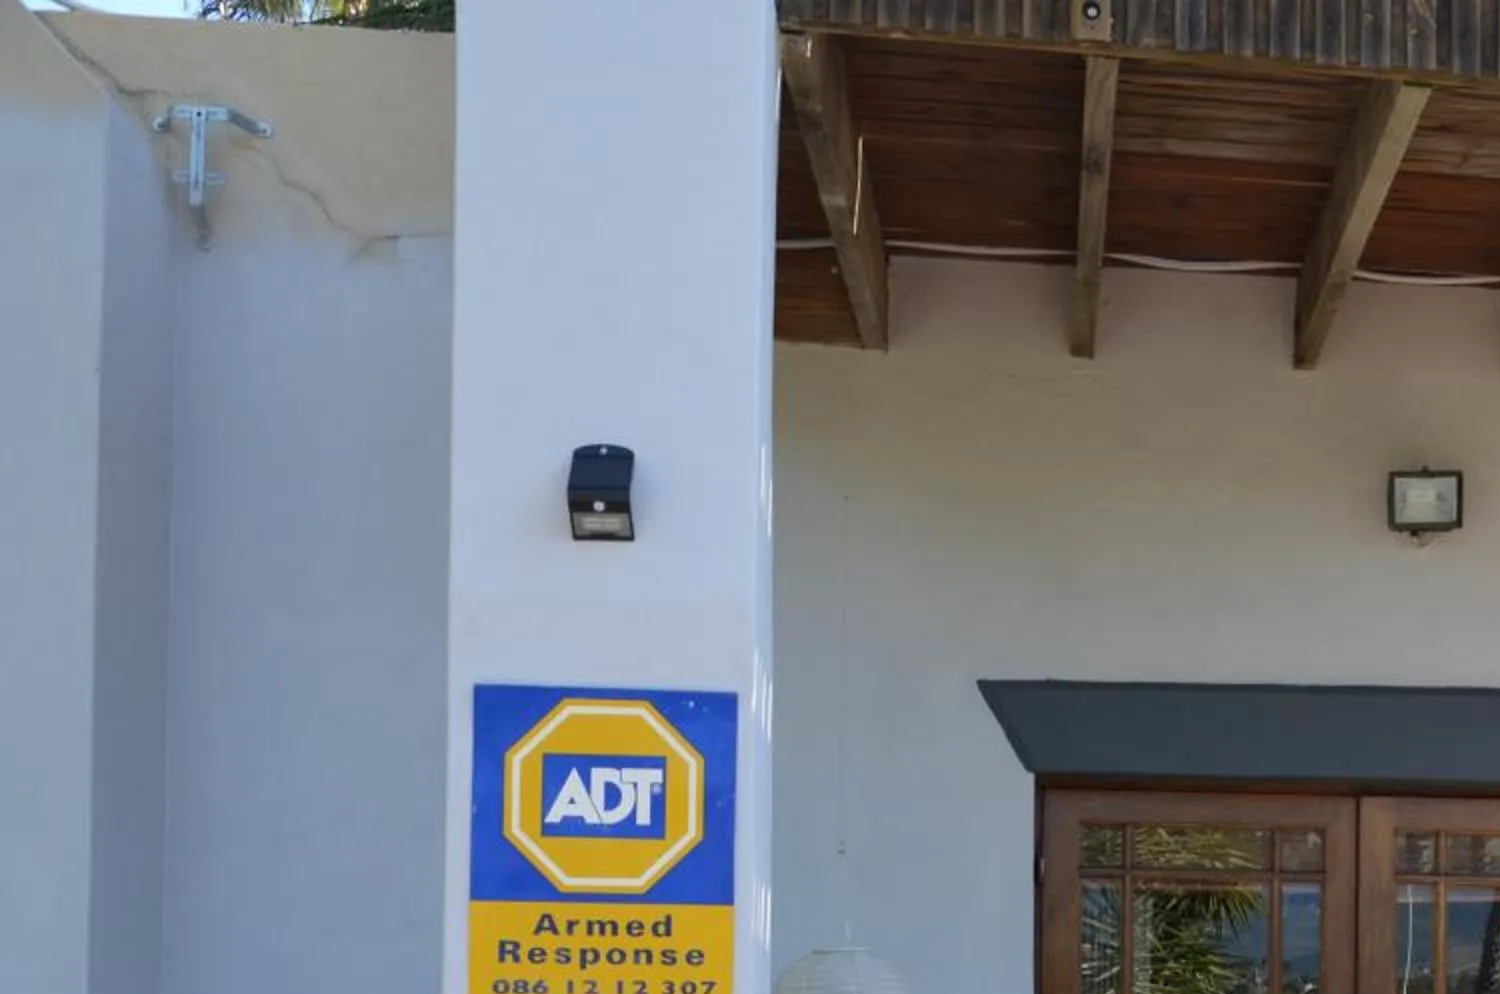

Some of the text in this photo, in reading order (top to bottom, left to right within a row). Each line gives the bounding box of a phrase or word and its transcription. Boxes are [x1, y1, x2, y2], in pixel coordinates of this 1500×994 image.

[544, 767, 663, 825] ADT
[533, 913, 673, 937] Armed
[497, 939, 705, 970] Response
